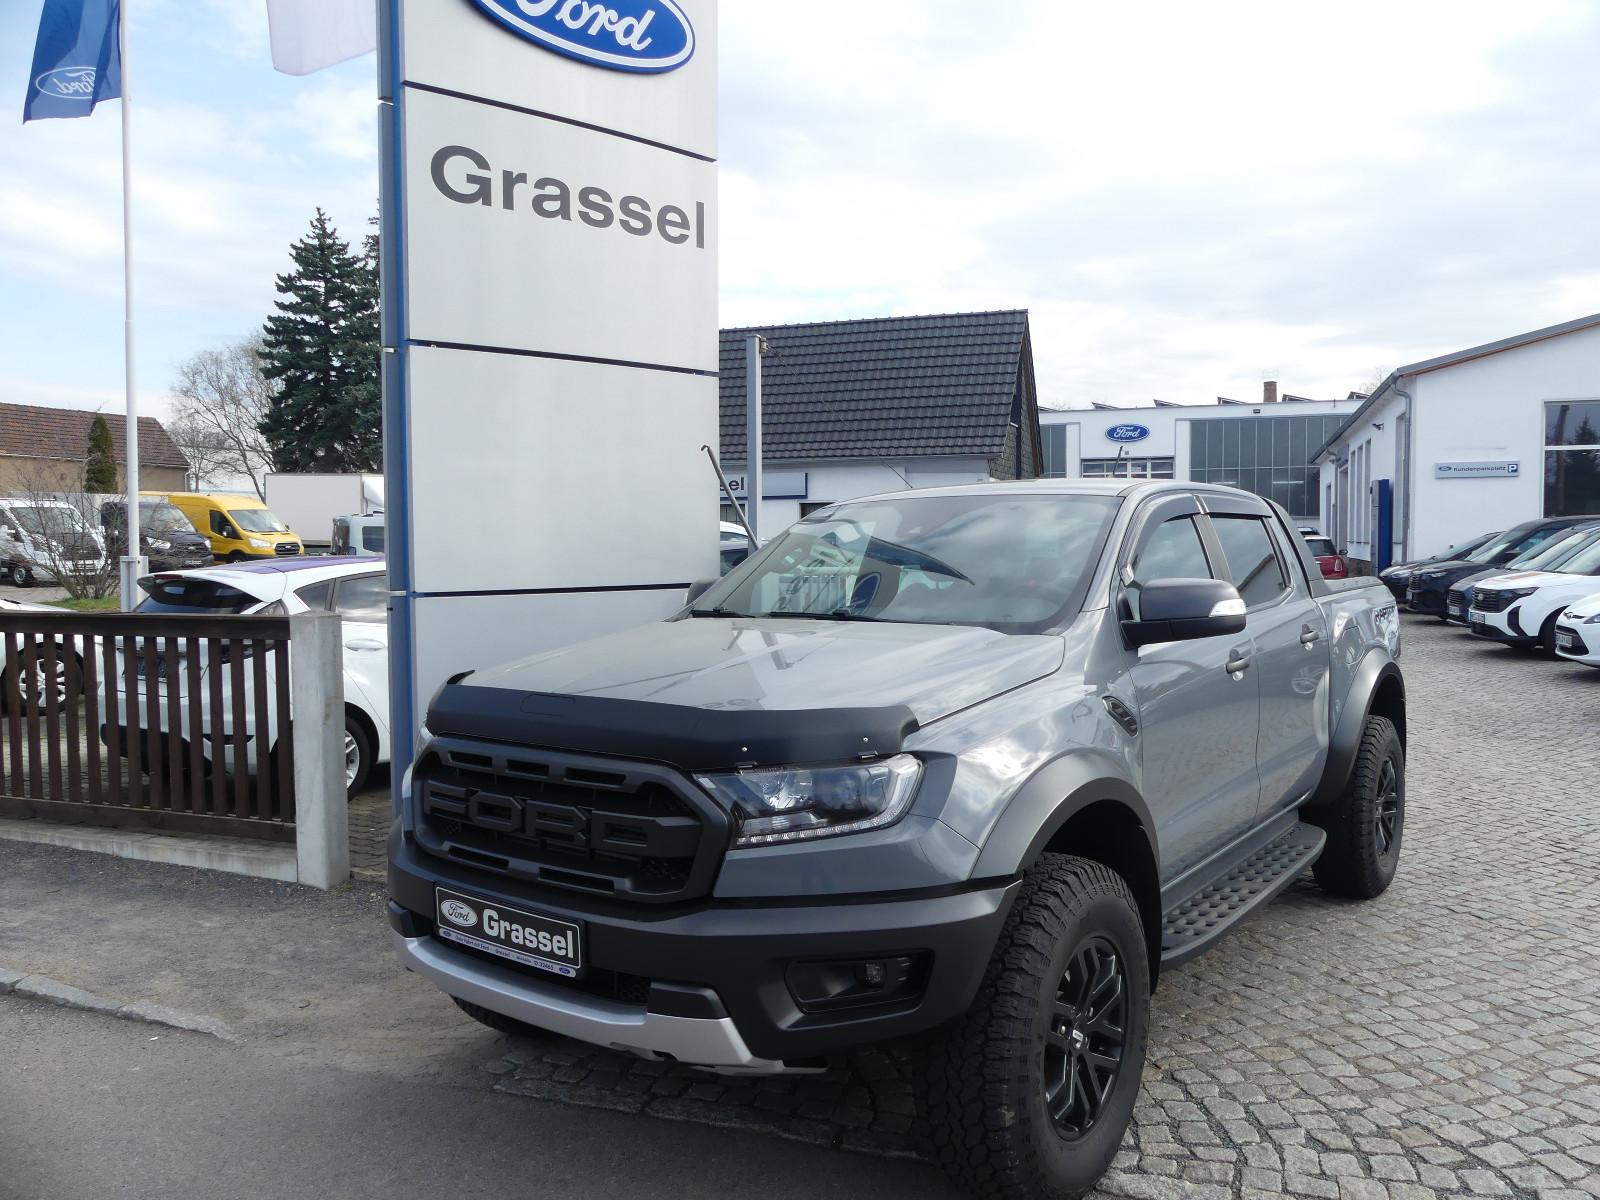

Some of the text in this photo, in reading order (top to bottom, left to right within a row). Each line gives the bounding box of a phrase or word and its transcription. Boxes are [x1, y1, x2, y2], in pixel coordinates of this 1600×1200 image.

[430, 144, 705, 250] Grassel
[1113, 426, 1141, 438] Ford
[447, 903, 574, 959] Ford Grassel
